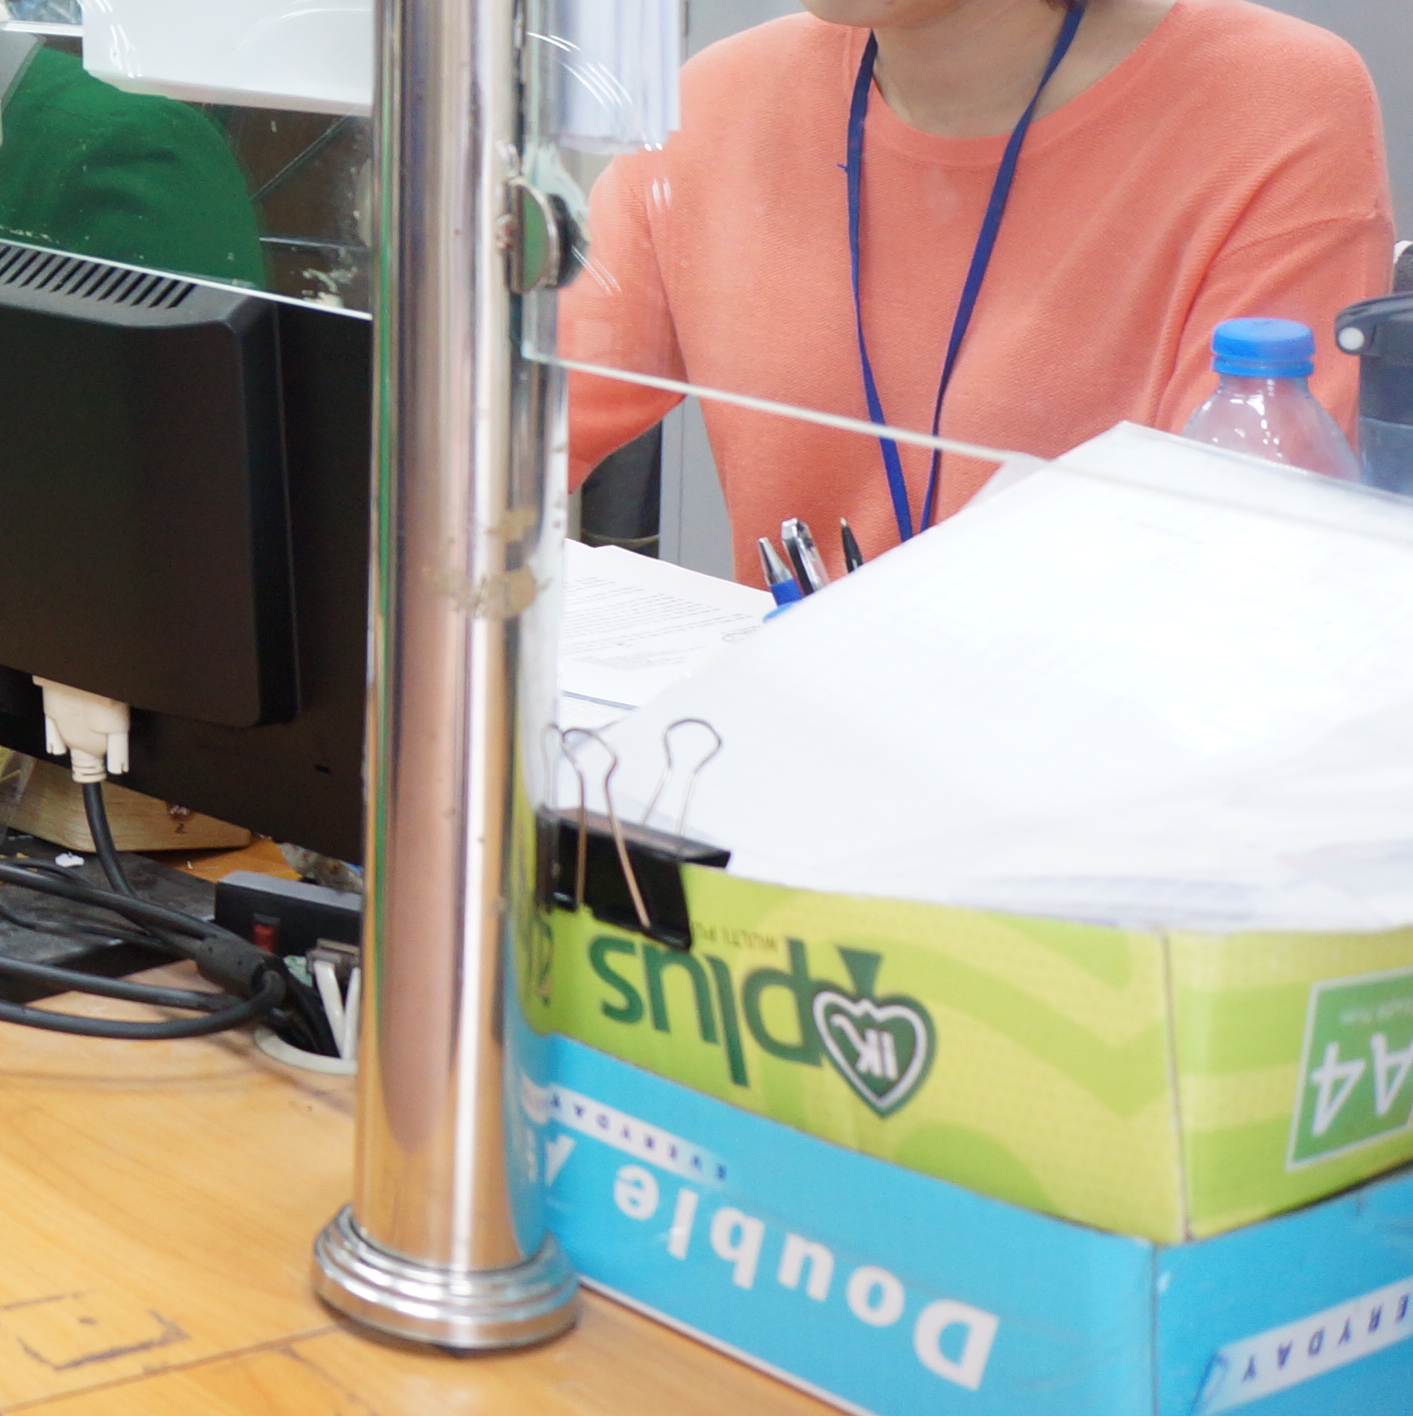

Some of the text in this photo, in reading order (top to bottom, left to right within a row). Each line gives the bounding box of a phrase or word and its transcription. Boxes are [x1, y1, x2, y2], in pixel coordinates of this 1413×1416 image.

[588, 934, 824, 1089] plus
[613, 1164, 1000, 1391] Double
[1241, 1292, 1411, 1384] ERYDAY
